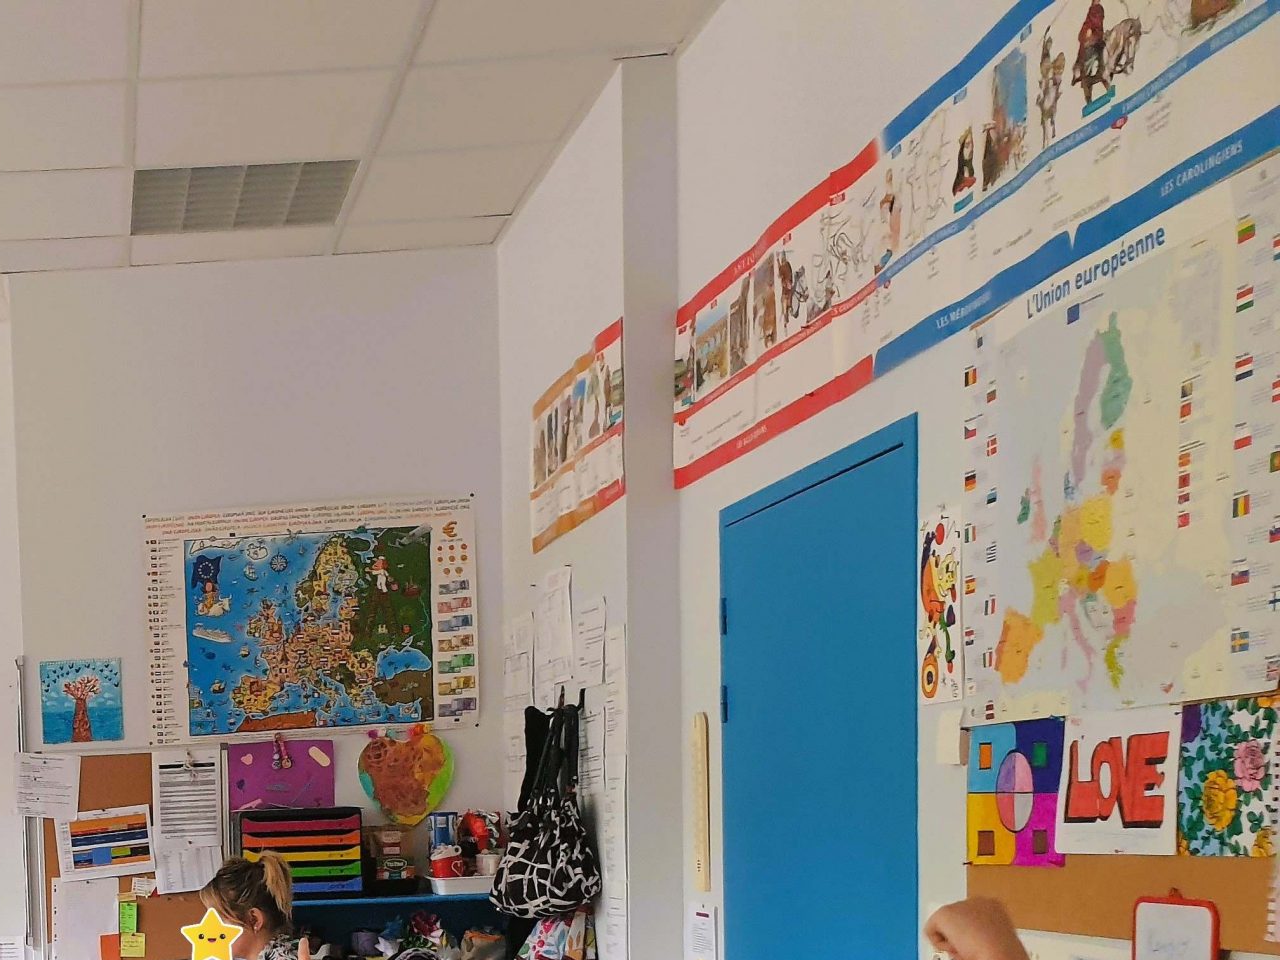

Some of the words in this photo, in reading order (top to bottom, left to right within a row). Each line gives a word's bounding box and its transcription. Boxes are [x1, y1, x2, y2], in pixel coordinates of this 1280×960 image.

[1027, 278, 1070, 319] L'Union
[1075, 226, 1166, 289] européenne
[1063, 731, 1170, 829] LOVE
